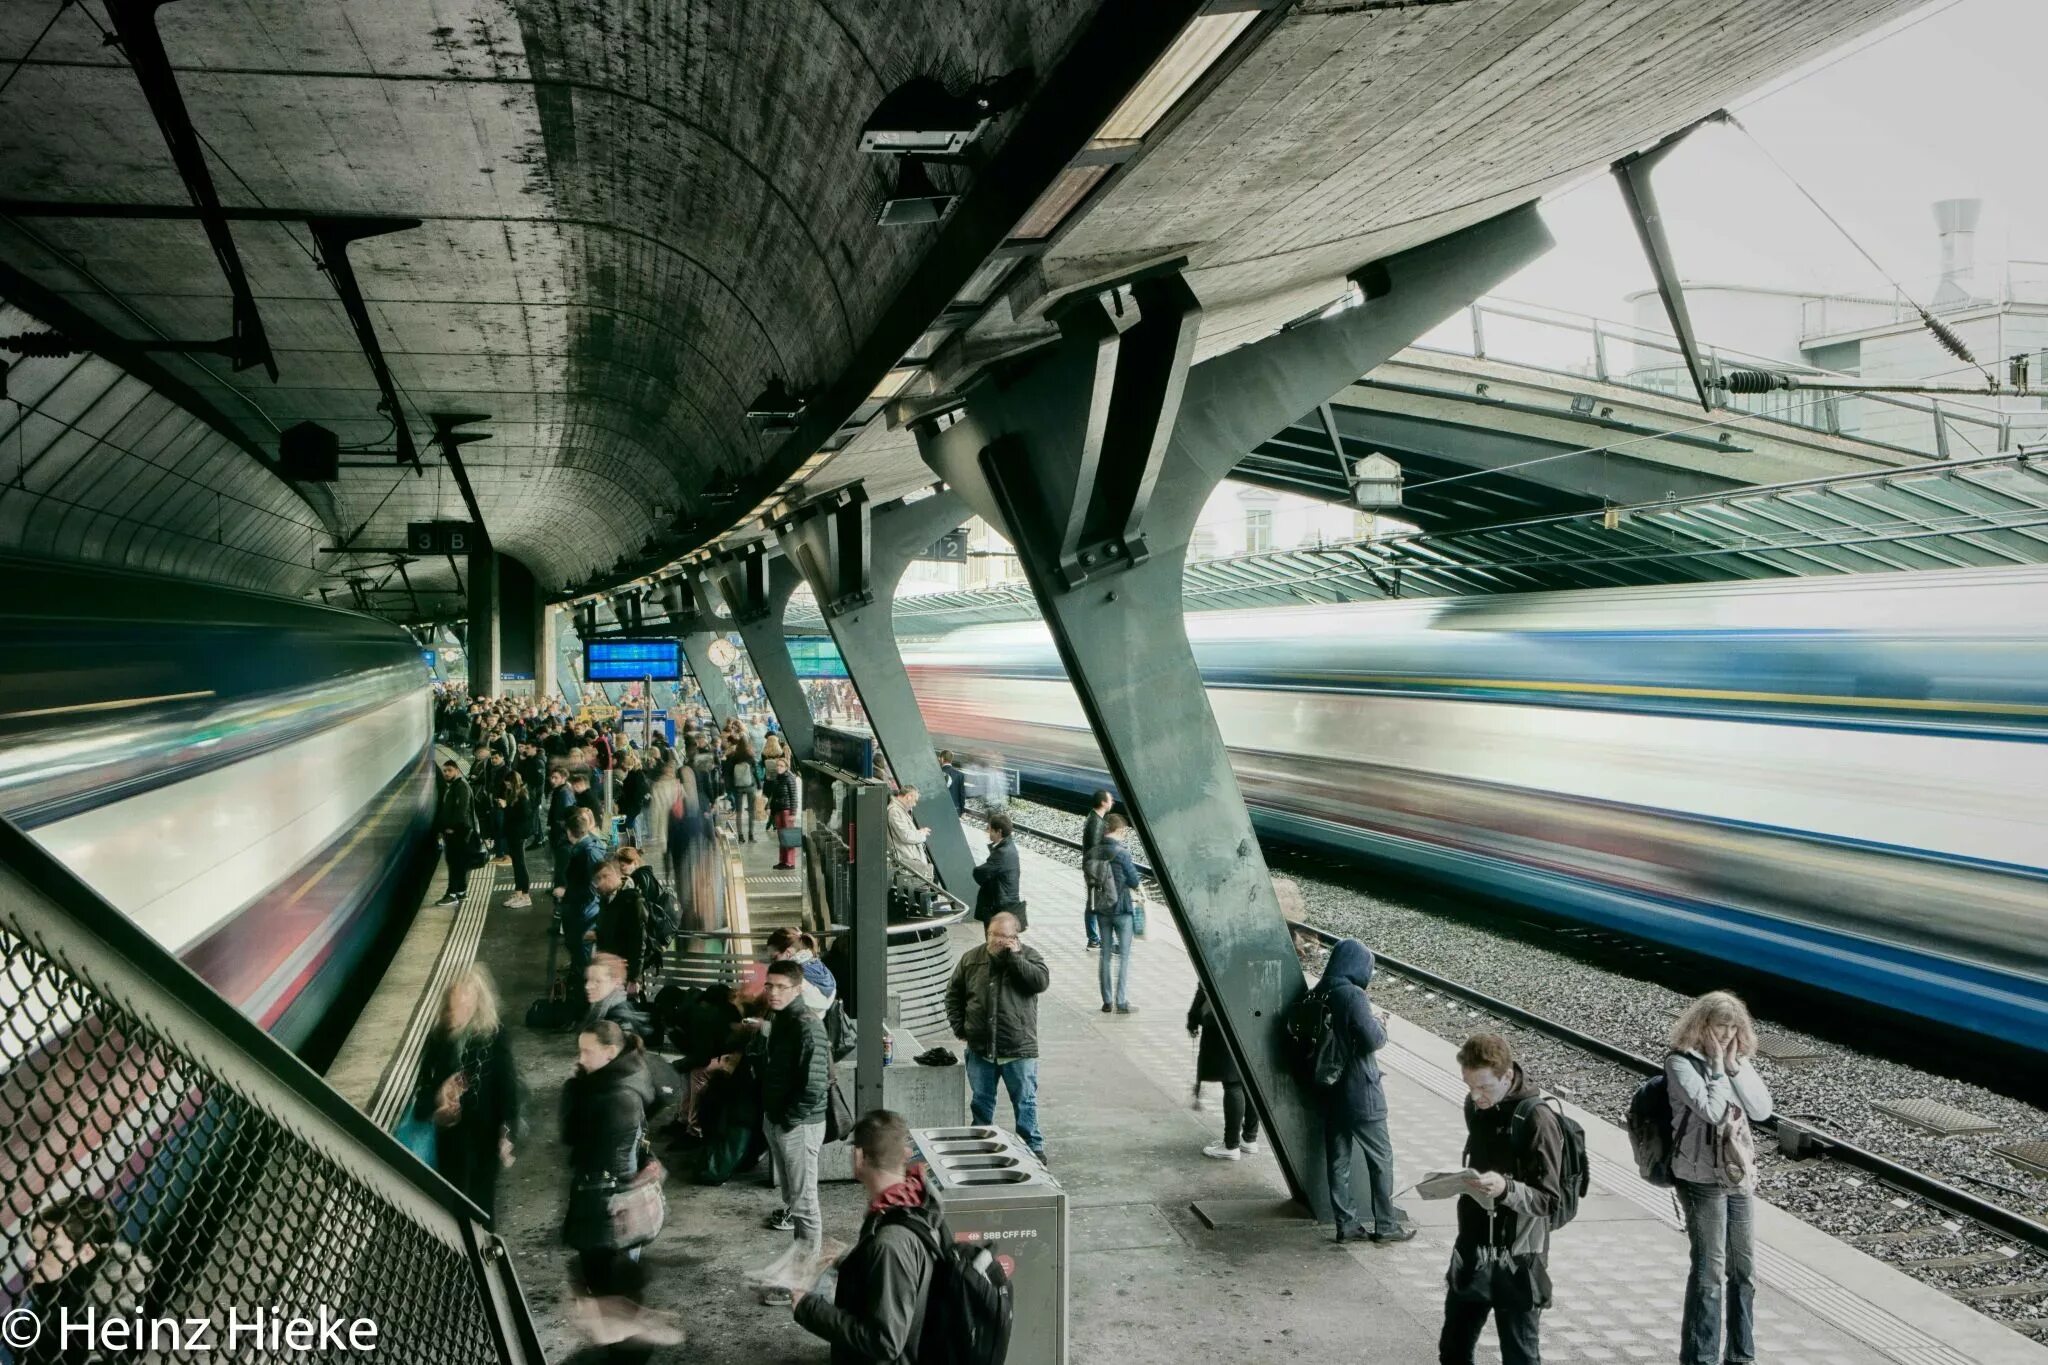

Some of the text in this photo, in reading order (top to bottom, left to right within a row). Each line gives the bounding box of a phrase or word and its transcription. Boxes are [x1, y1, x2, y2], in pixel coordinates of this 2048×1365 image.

[419, 533, 464, 549] 3 B
[947, 541, 958, 557] 2
[983, 1229, 1038, 1240] SBB CFF FFS
